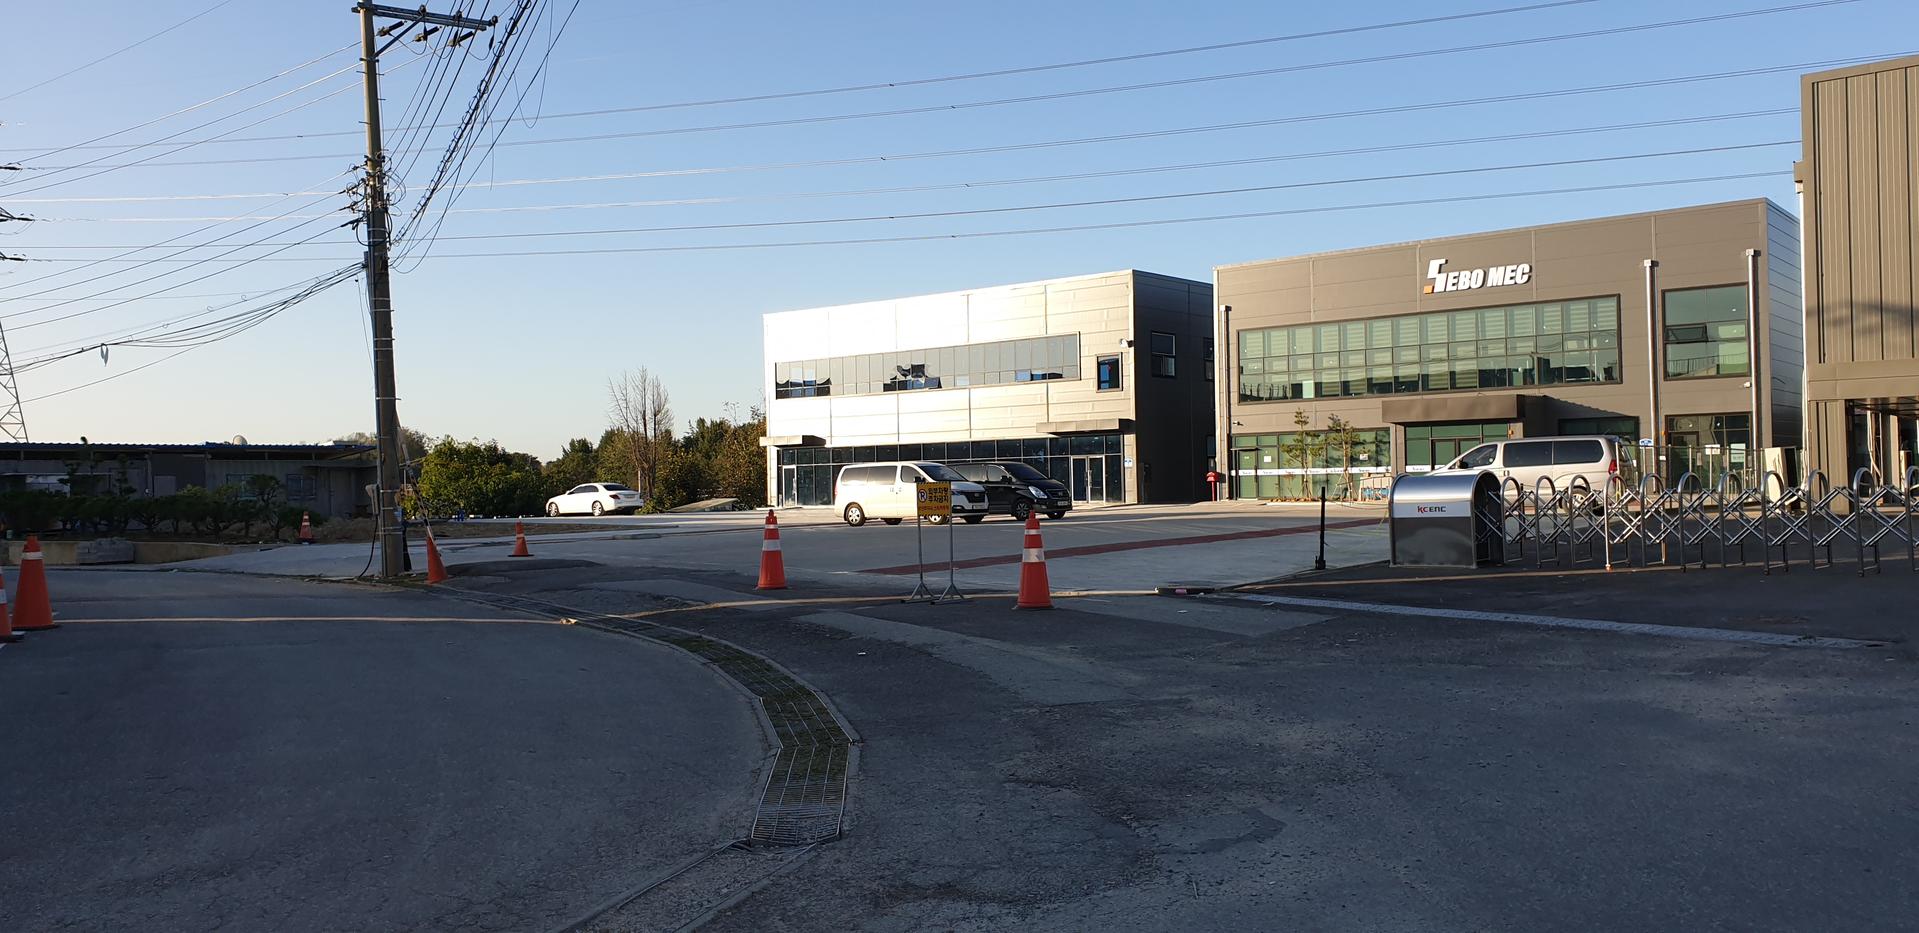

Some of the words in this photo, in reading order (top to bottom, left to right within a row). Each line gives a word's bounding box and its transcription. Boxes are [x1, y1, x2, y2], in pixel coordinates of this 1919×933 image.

[1423, 258, 1485, 294] SEBO
[1486, 263, 1531, 287] MEC
[928, 495, 949, 504] 주차금지
